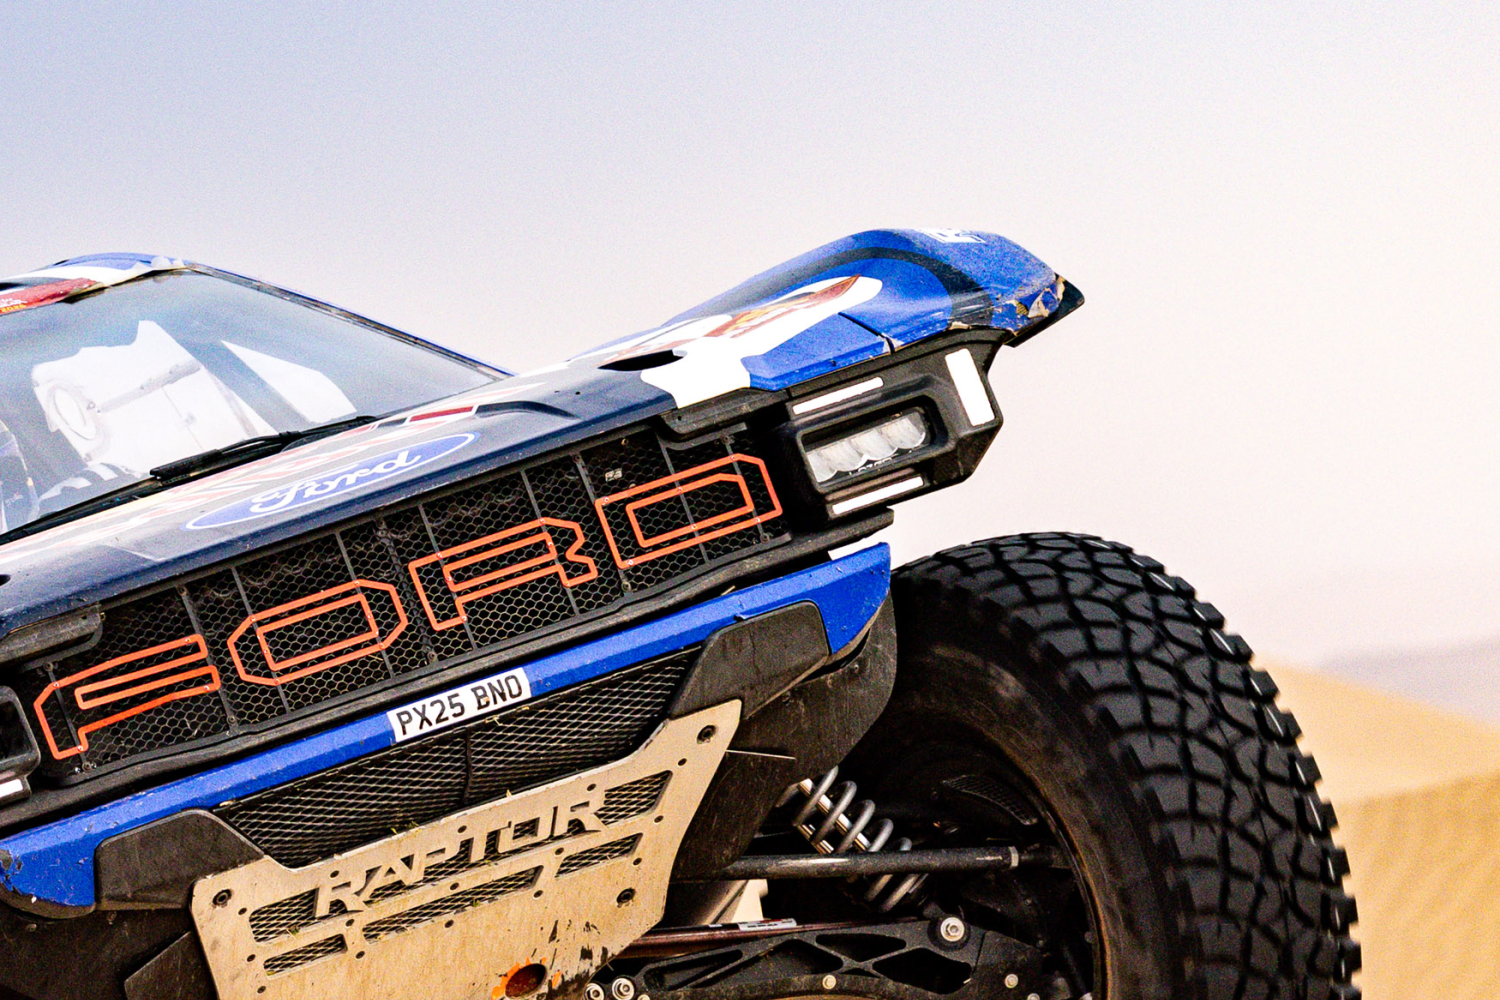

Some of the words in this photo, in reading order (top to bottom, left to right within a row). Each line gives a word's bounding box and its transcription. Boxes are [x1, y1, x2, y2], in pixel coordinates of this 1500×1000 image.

[249, 450, 422, 513] Ford
[32, 453, 783, 761] FORD
[396, 692, 466, 736] PX25
[315, 797, 607, 918] RAPTOR
